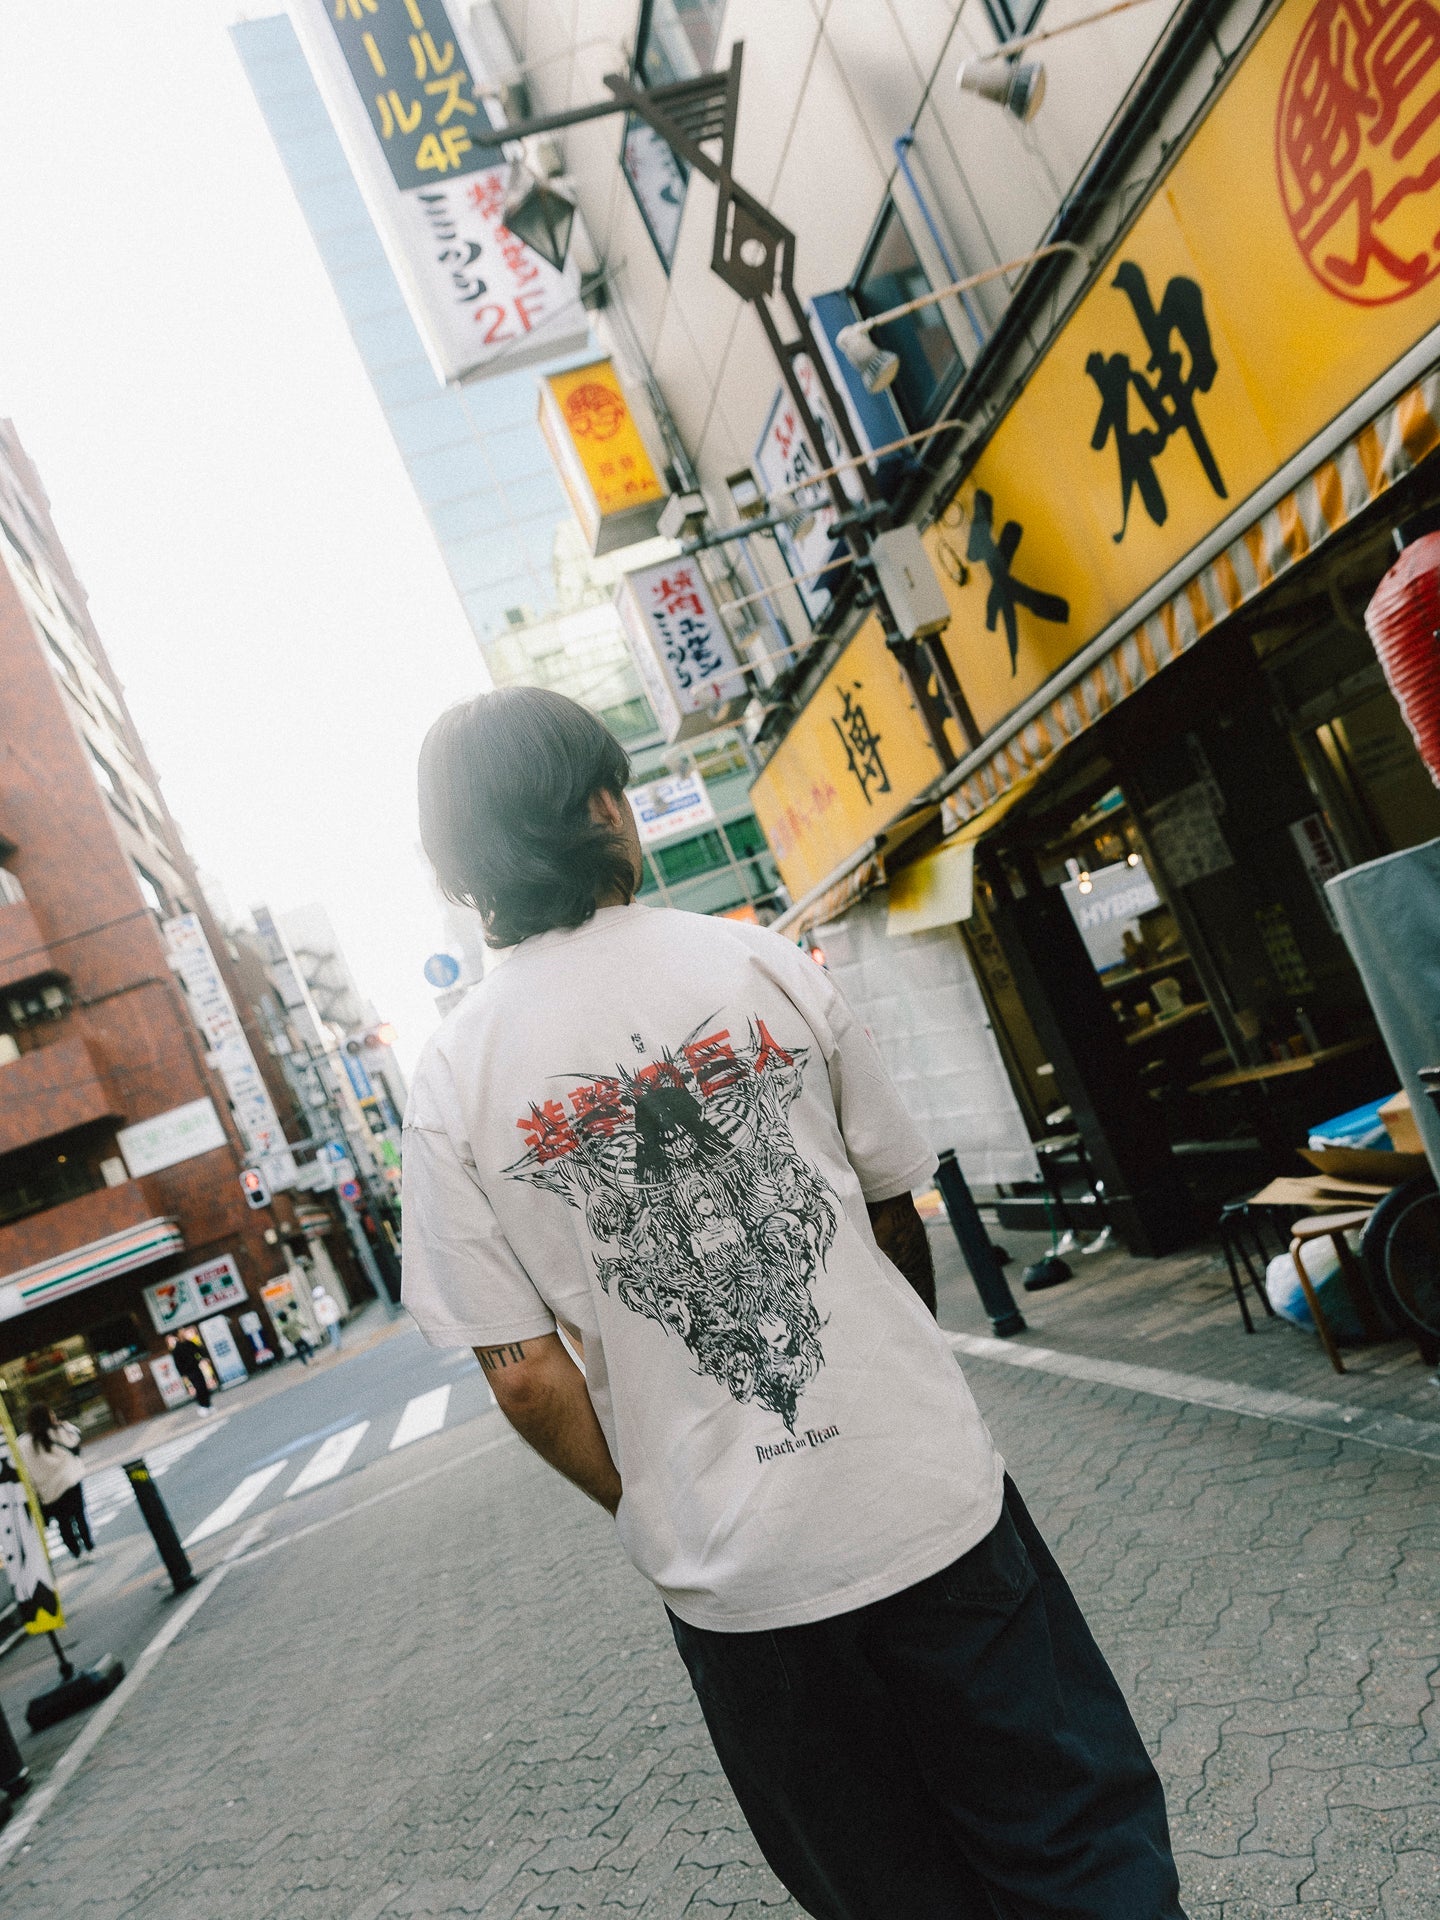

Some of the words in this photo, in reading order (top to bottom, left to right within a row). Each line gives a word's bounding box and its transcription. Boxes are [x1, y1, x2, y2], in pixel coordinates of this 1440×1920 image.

[415, 126, 472, 173] 4F
[474, 287, 544, 344] 2F
[755, 1439, 795, 1463] Attack
[805, 1425, 839, 1448] Titan
